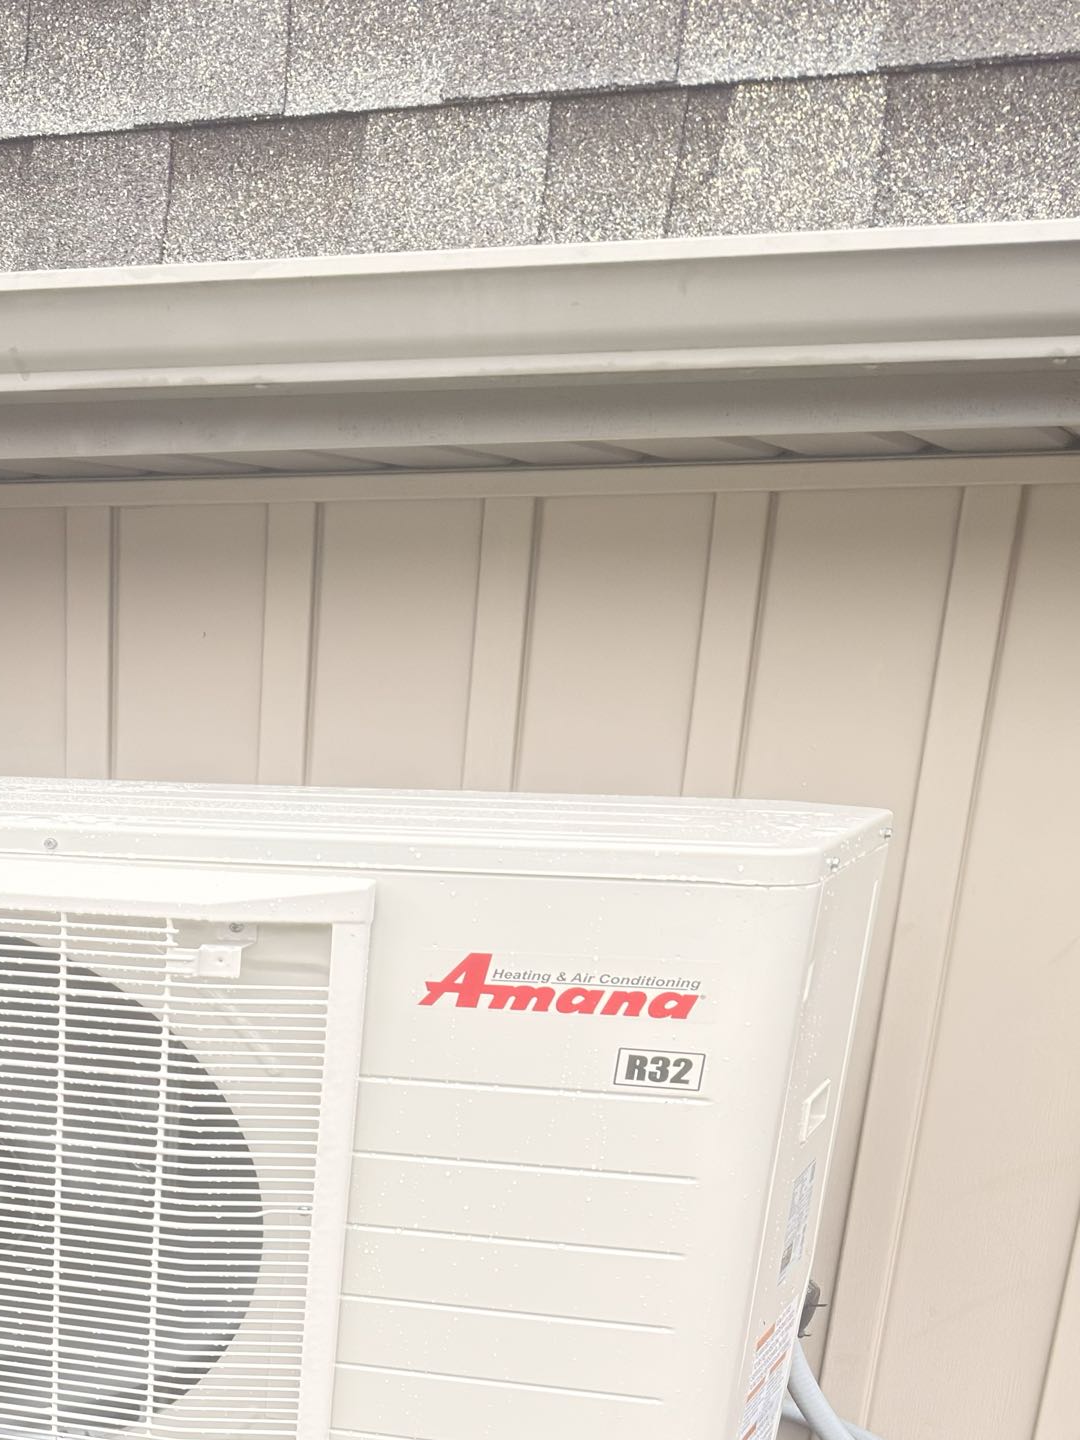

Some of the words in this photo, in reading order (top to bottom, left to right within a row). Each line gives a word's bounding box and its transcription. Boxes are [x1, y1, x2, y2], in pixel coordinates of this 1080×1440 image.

[417, 952, 700, 1020] Amana
[492, 968, 551, 984] Heating
[556, 971, 568, 982] &
[571, 972, 595, 984] Air
[599, 973, 701, 991] Conditioning
[625, 1054, 694, 1085] R32
